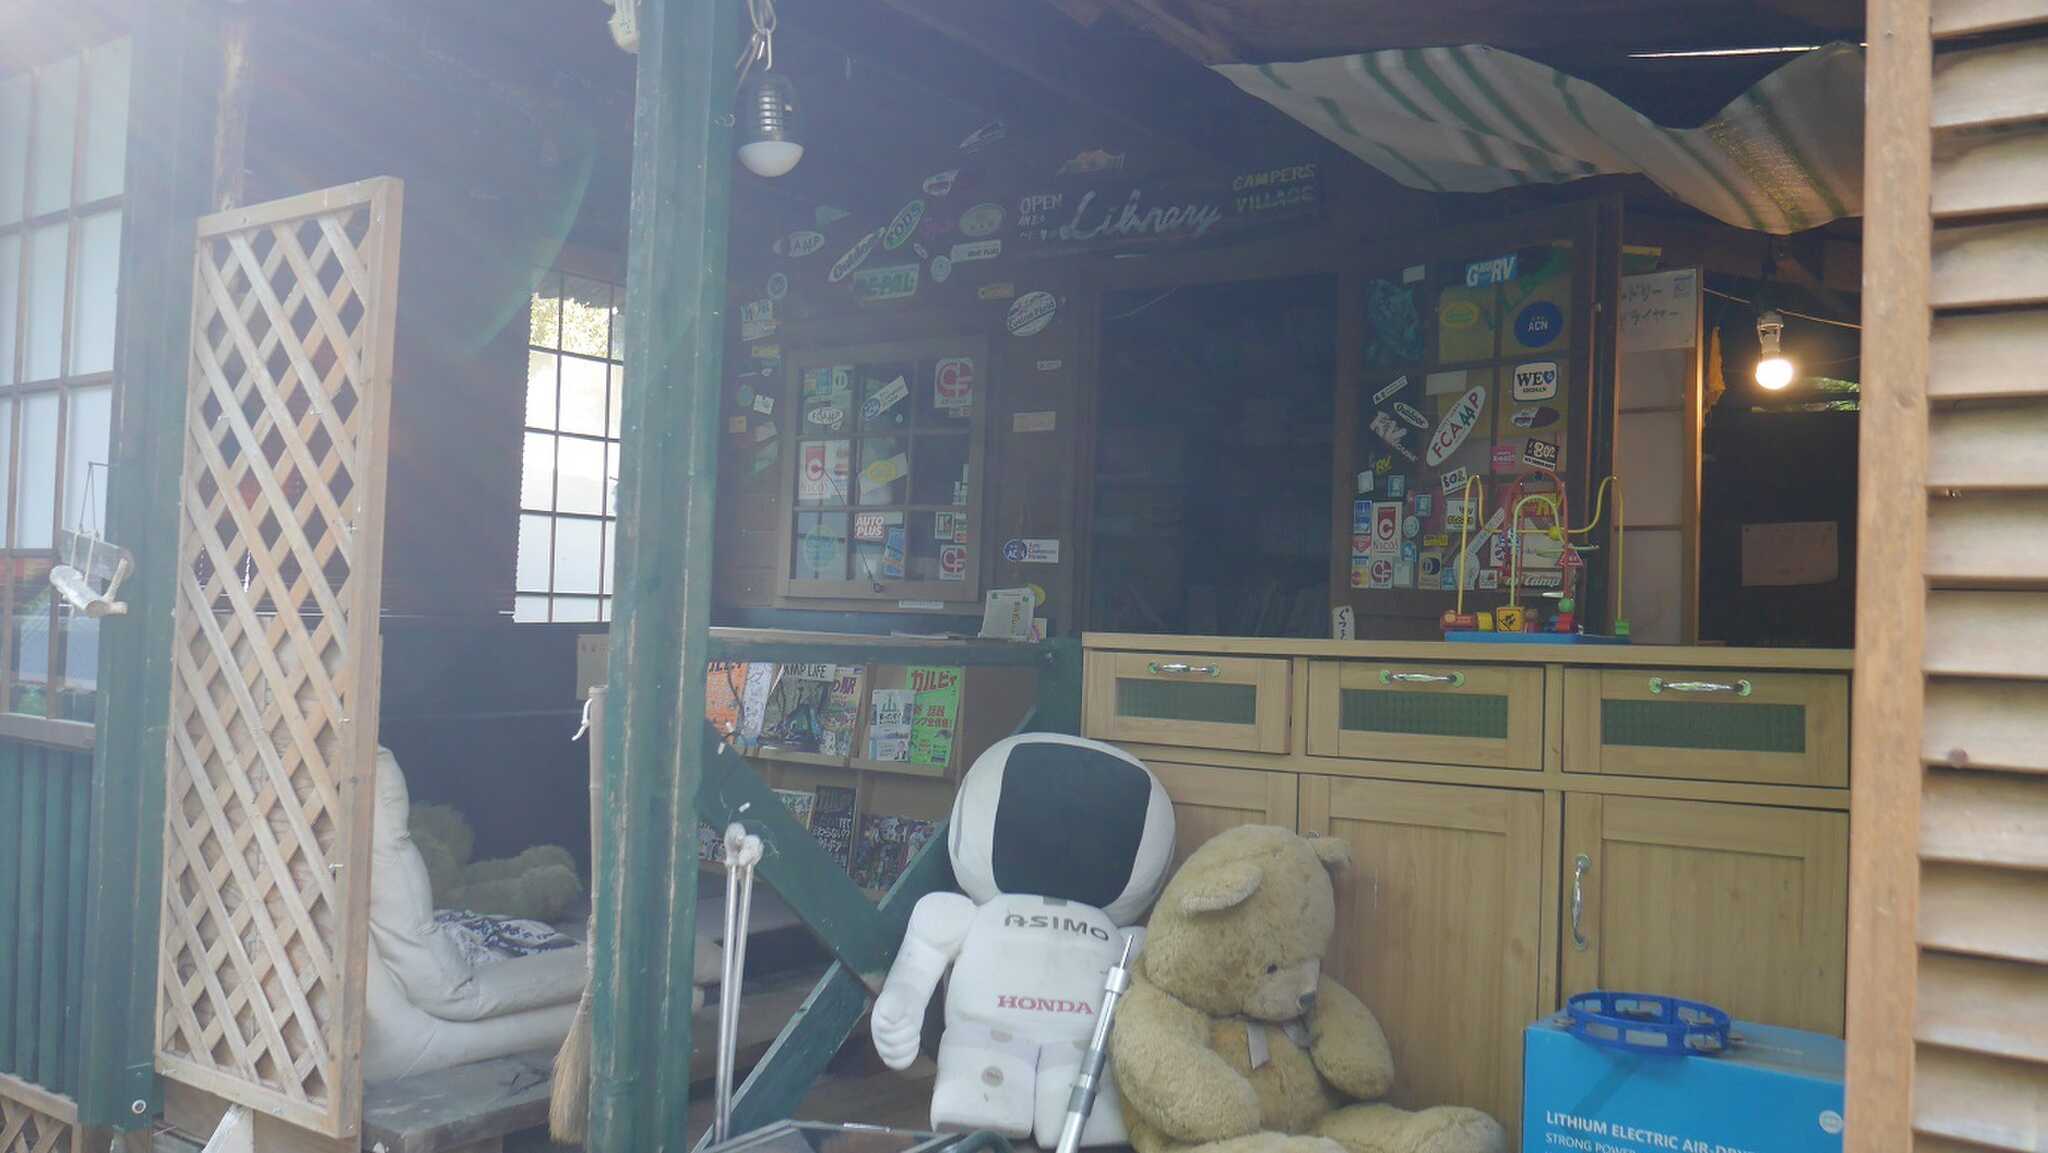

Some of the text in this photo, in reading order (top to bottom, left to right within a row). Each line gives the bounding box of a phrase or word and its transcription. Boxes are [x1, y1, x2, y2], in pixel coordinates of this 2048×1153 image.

[1232, 163, 1317, 191] CAMPERS
[1018, 193, 1063, 215] OPEN
[1235, 185, 1315, 213] VILLAGE
[1059, 187, 1223, 240] Library
[856, 515, 885, 526] AUTO
[856, 526, 883, 537] PLUS
[1004, 914, 1110, 942] ASIMO
[996, 995, 1095, 1016] HONDA
[1546, 1109, 1608, 1136] LITHIUM
[1611, 1123, 1680, 1149] ELECTRIC
[1545, 1132, 1592, 1152] STRONG
